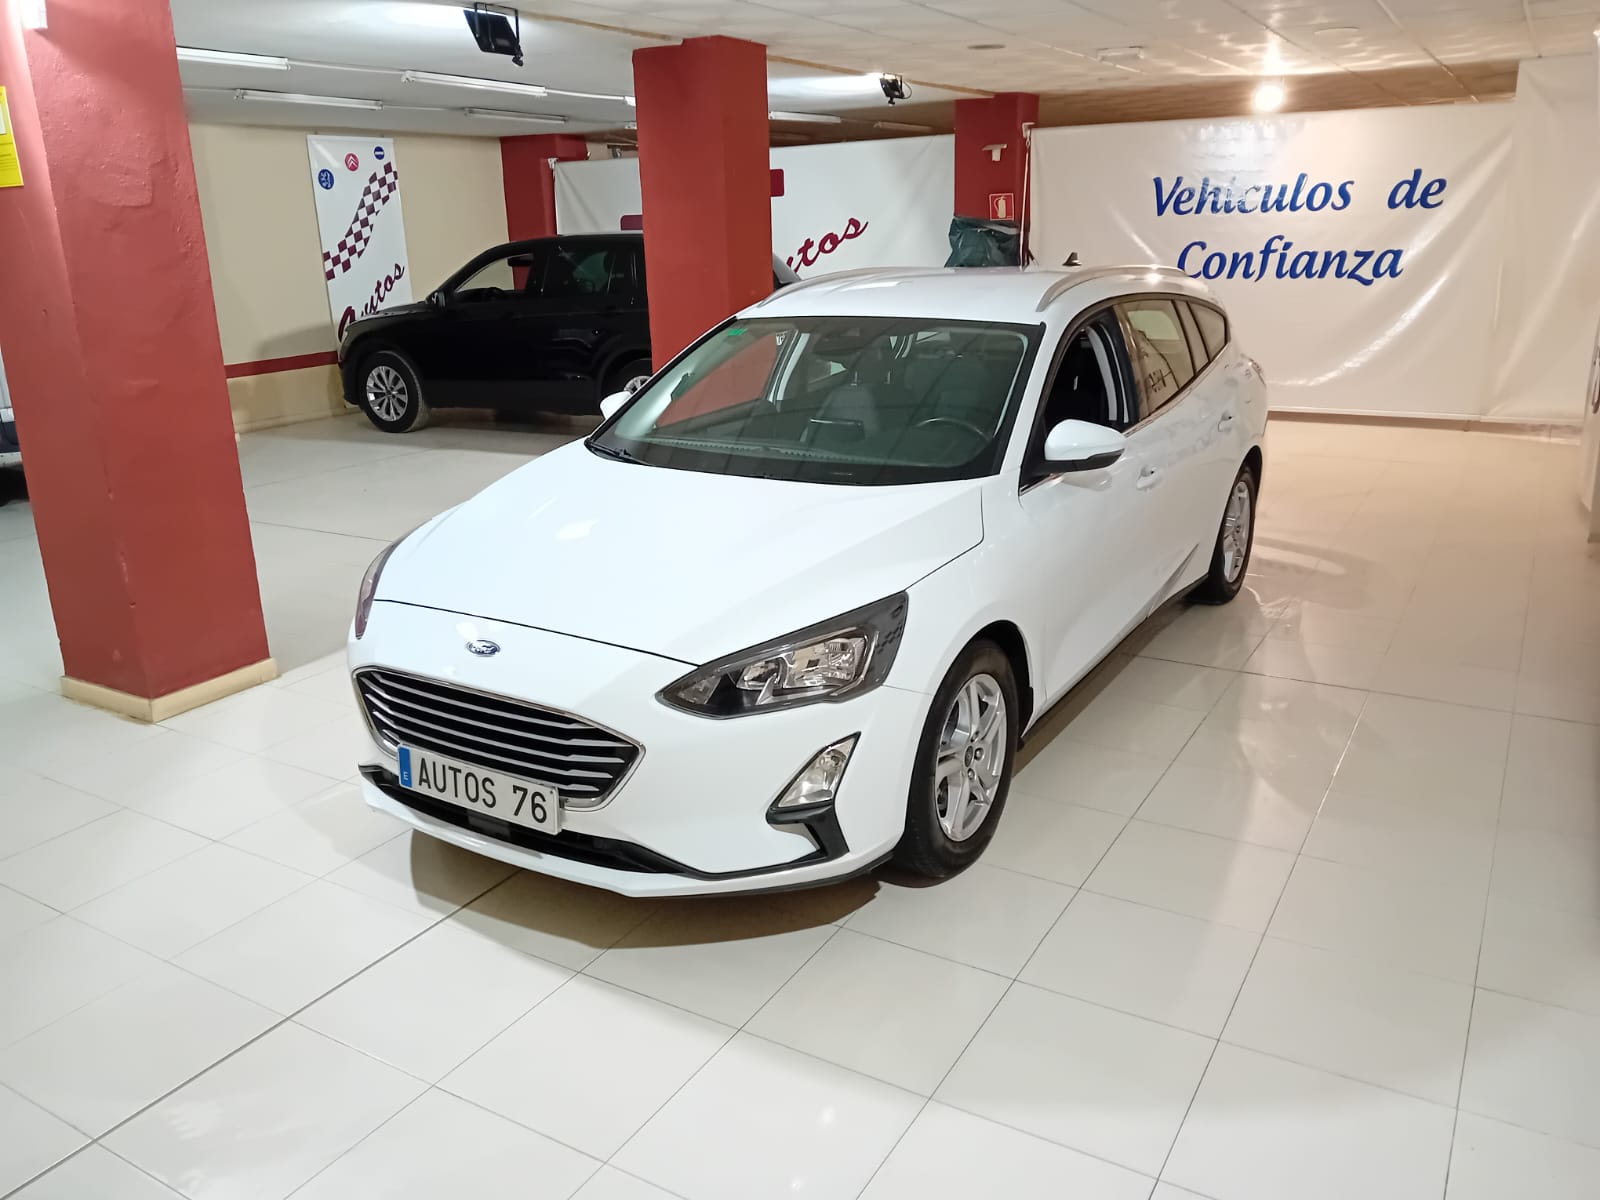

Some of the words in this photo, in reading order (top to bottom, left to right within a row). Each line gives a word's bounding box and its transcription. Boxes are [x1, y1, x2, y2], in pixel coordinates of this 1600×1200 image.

[1387, 168, 1447, 210] de
[1177, 234, 1404, 286] Confianza
[403, 771, 409, 781] E
[418, 757, 497, 809] AUTOS
[512, 784, 547, 824] 76
